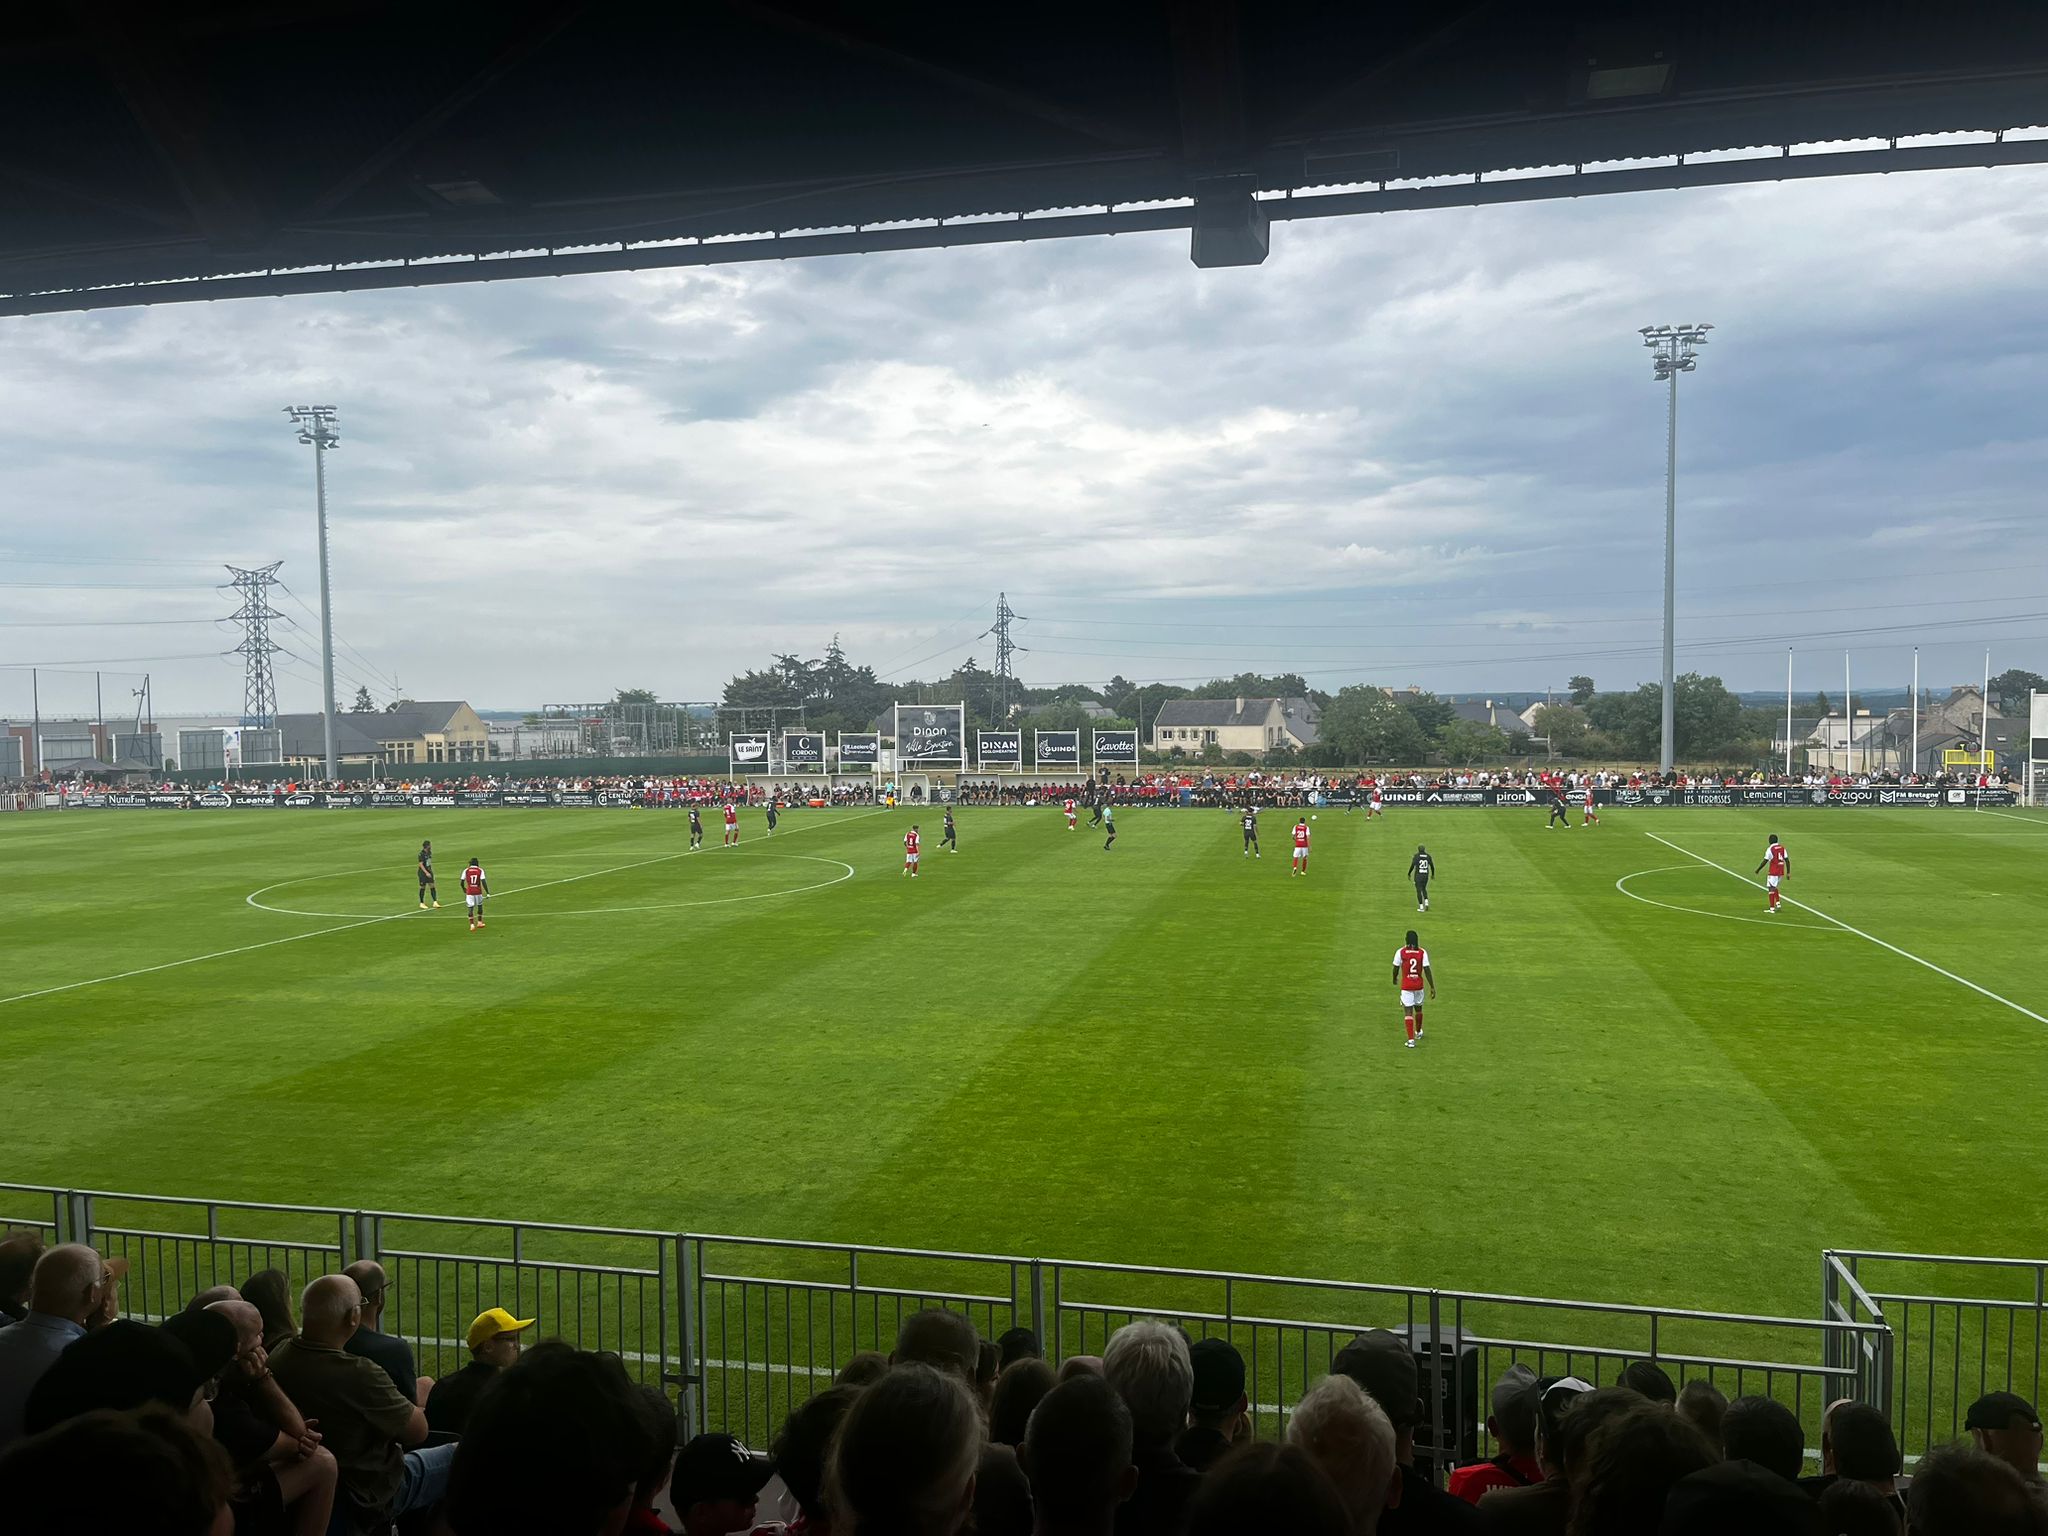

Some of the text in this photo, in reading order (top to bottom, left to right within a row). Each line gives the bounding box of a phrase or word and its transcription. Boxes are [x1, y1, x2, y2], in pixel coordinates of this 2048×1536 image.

[914, 727, 947, 736] Dinan
[982, 741, 1017, 750] DINAN
[1096, 737, 1135, 754] Gavottes
[1497, 792, 1526, 804] piron
[1684, 795, 1731, 804] LES TERRASSES
[1419, 859, 1428, 869] 20
[470, 874, 477, 884] 17
[1409, 958, 1417, 973] 2
